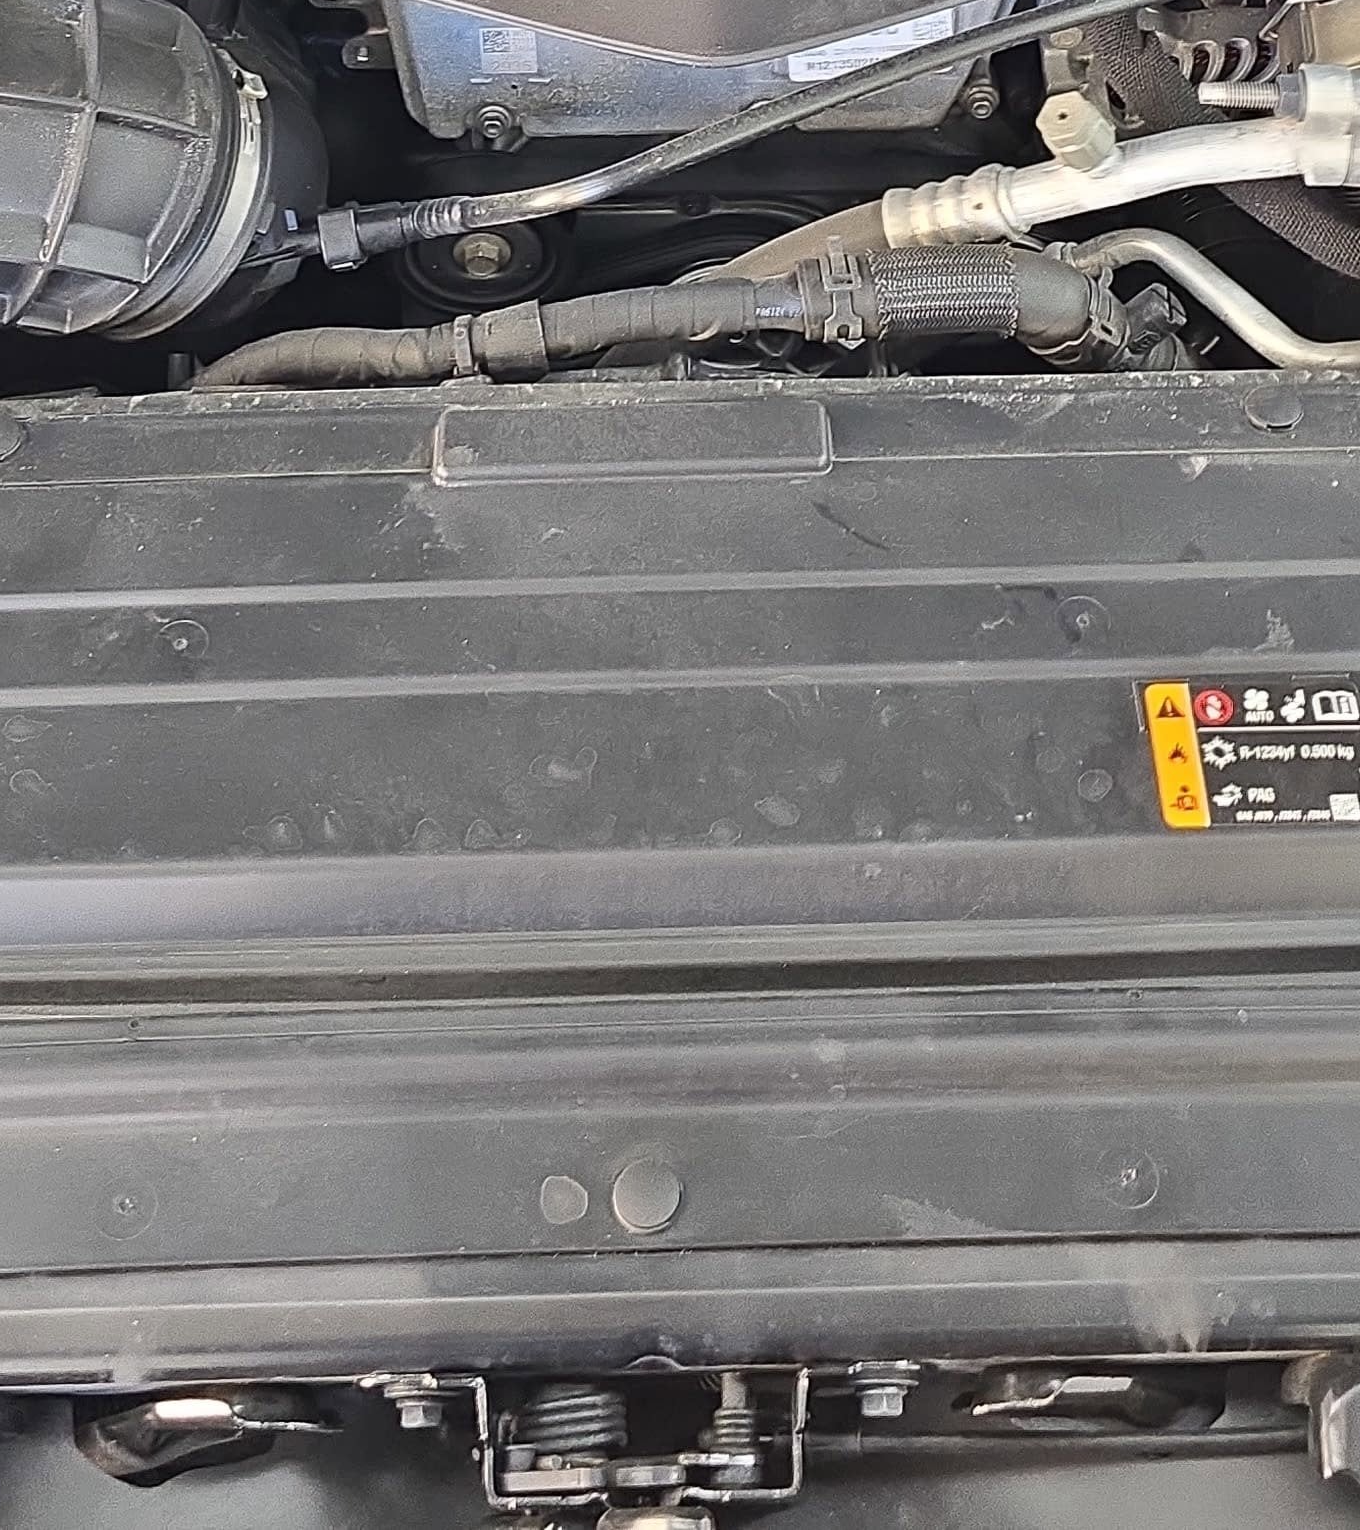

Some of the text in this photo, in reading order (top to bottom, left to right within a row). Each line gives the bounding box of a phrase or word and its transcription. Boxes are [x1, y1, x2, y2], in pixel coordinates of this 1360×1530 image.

[1245, 710, 1275, 724] AUTO
[1337, 744, 1355, 761] kg
[1247, 787, 1276, 804] PAG
